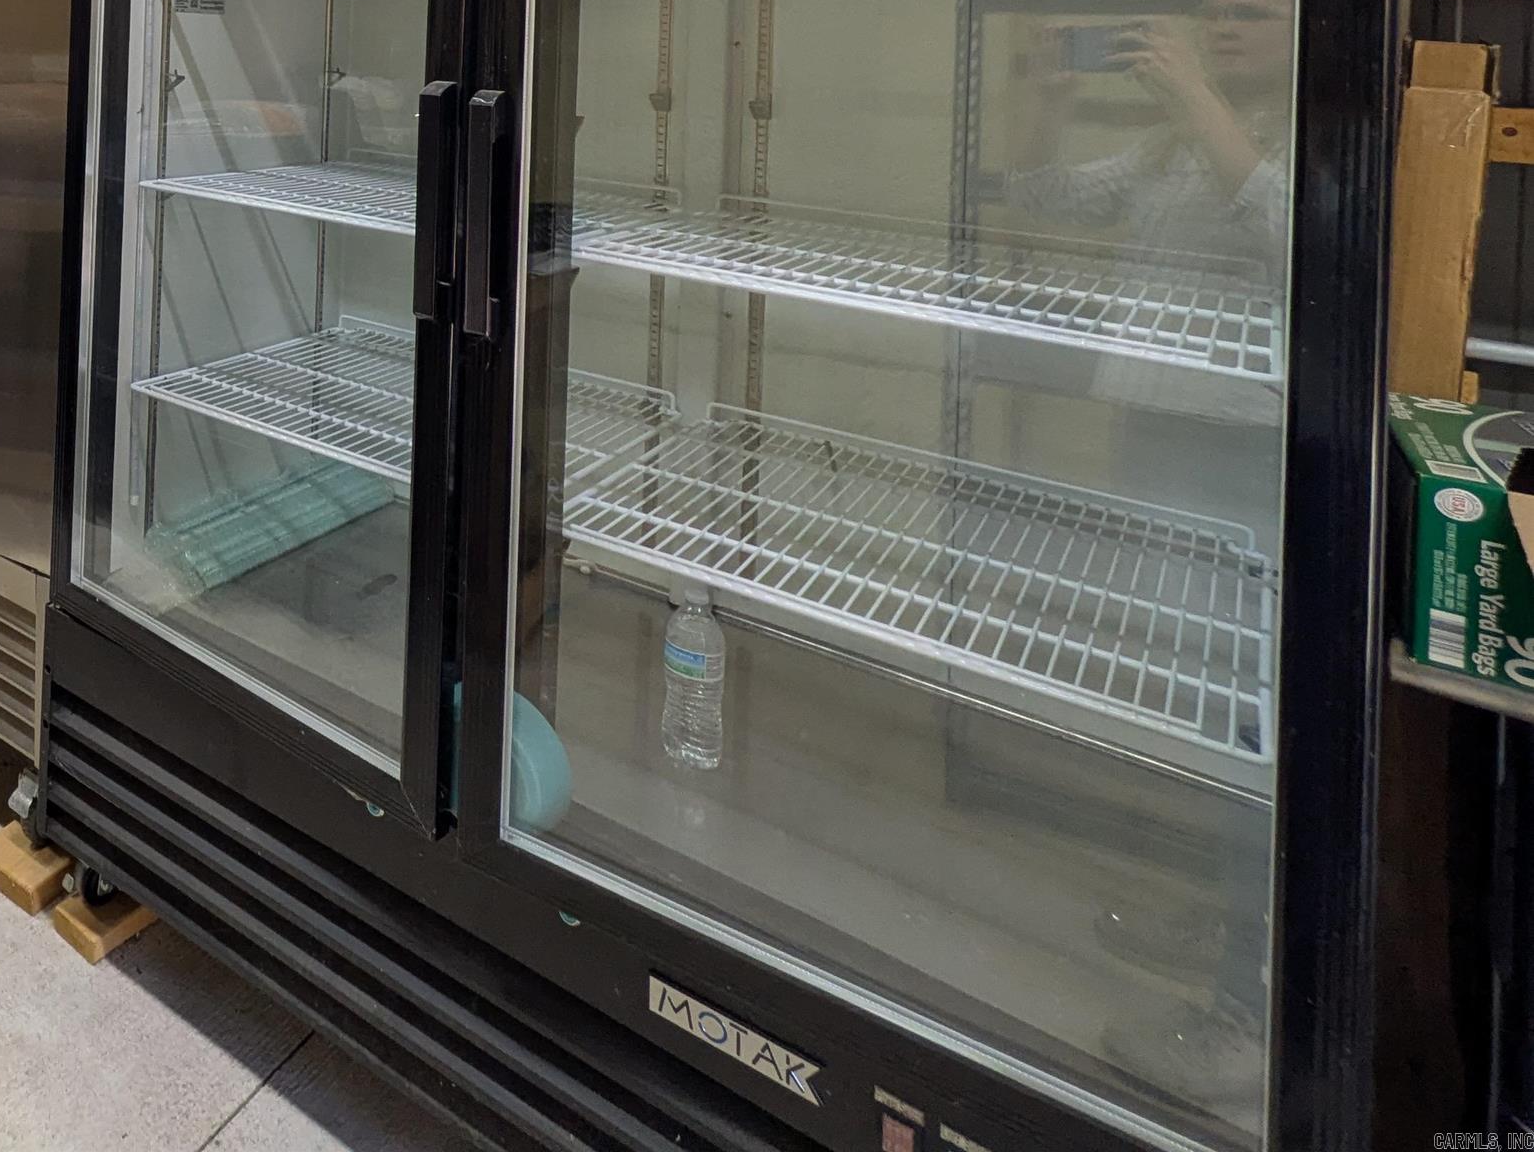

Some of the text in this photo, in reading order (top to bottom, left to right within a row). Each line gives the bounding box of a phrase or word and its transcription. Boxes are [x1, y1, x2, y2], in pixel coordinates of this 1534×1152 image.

[1472, 539, 1507, 677] Large Yard Bags
[657, 986, 806, 1094] MOTAK
